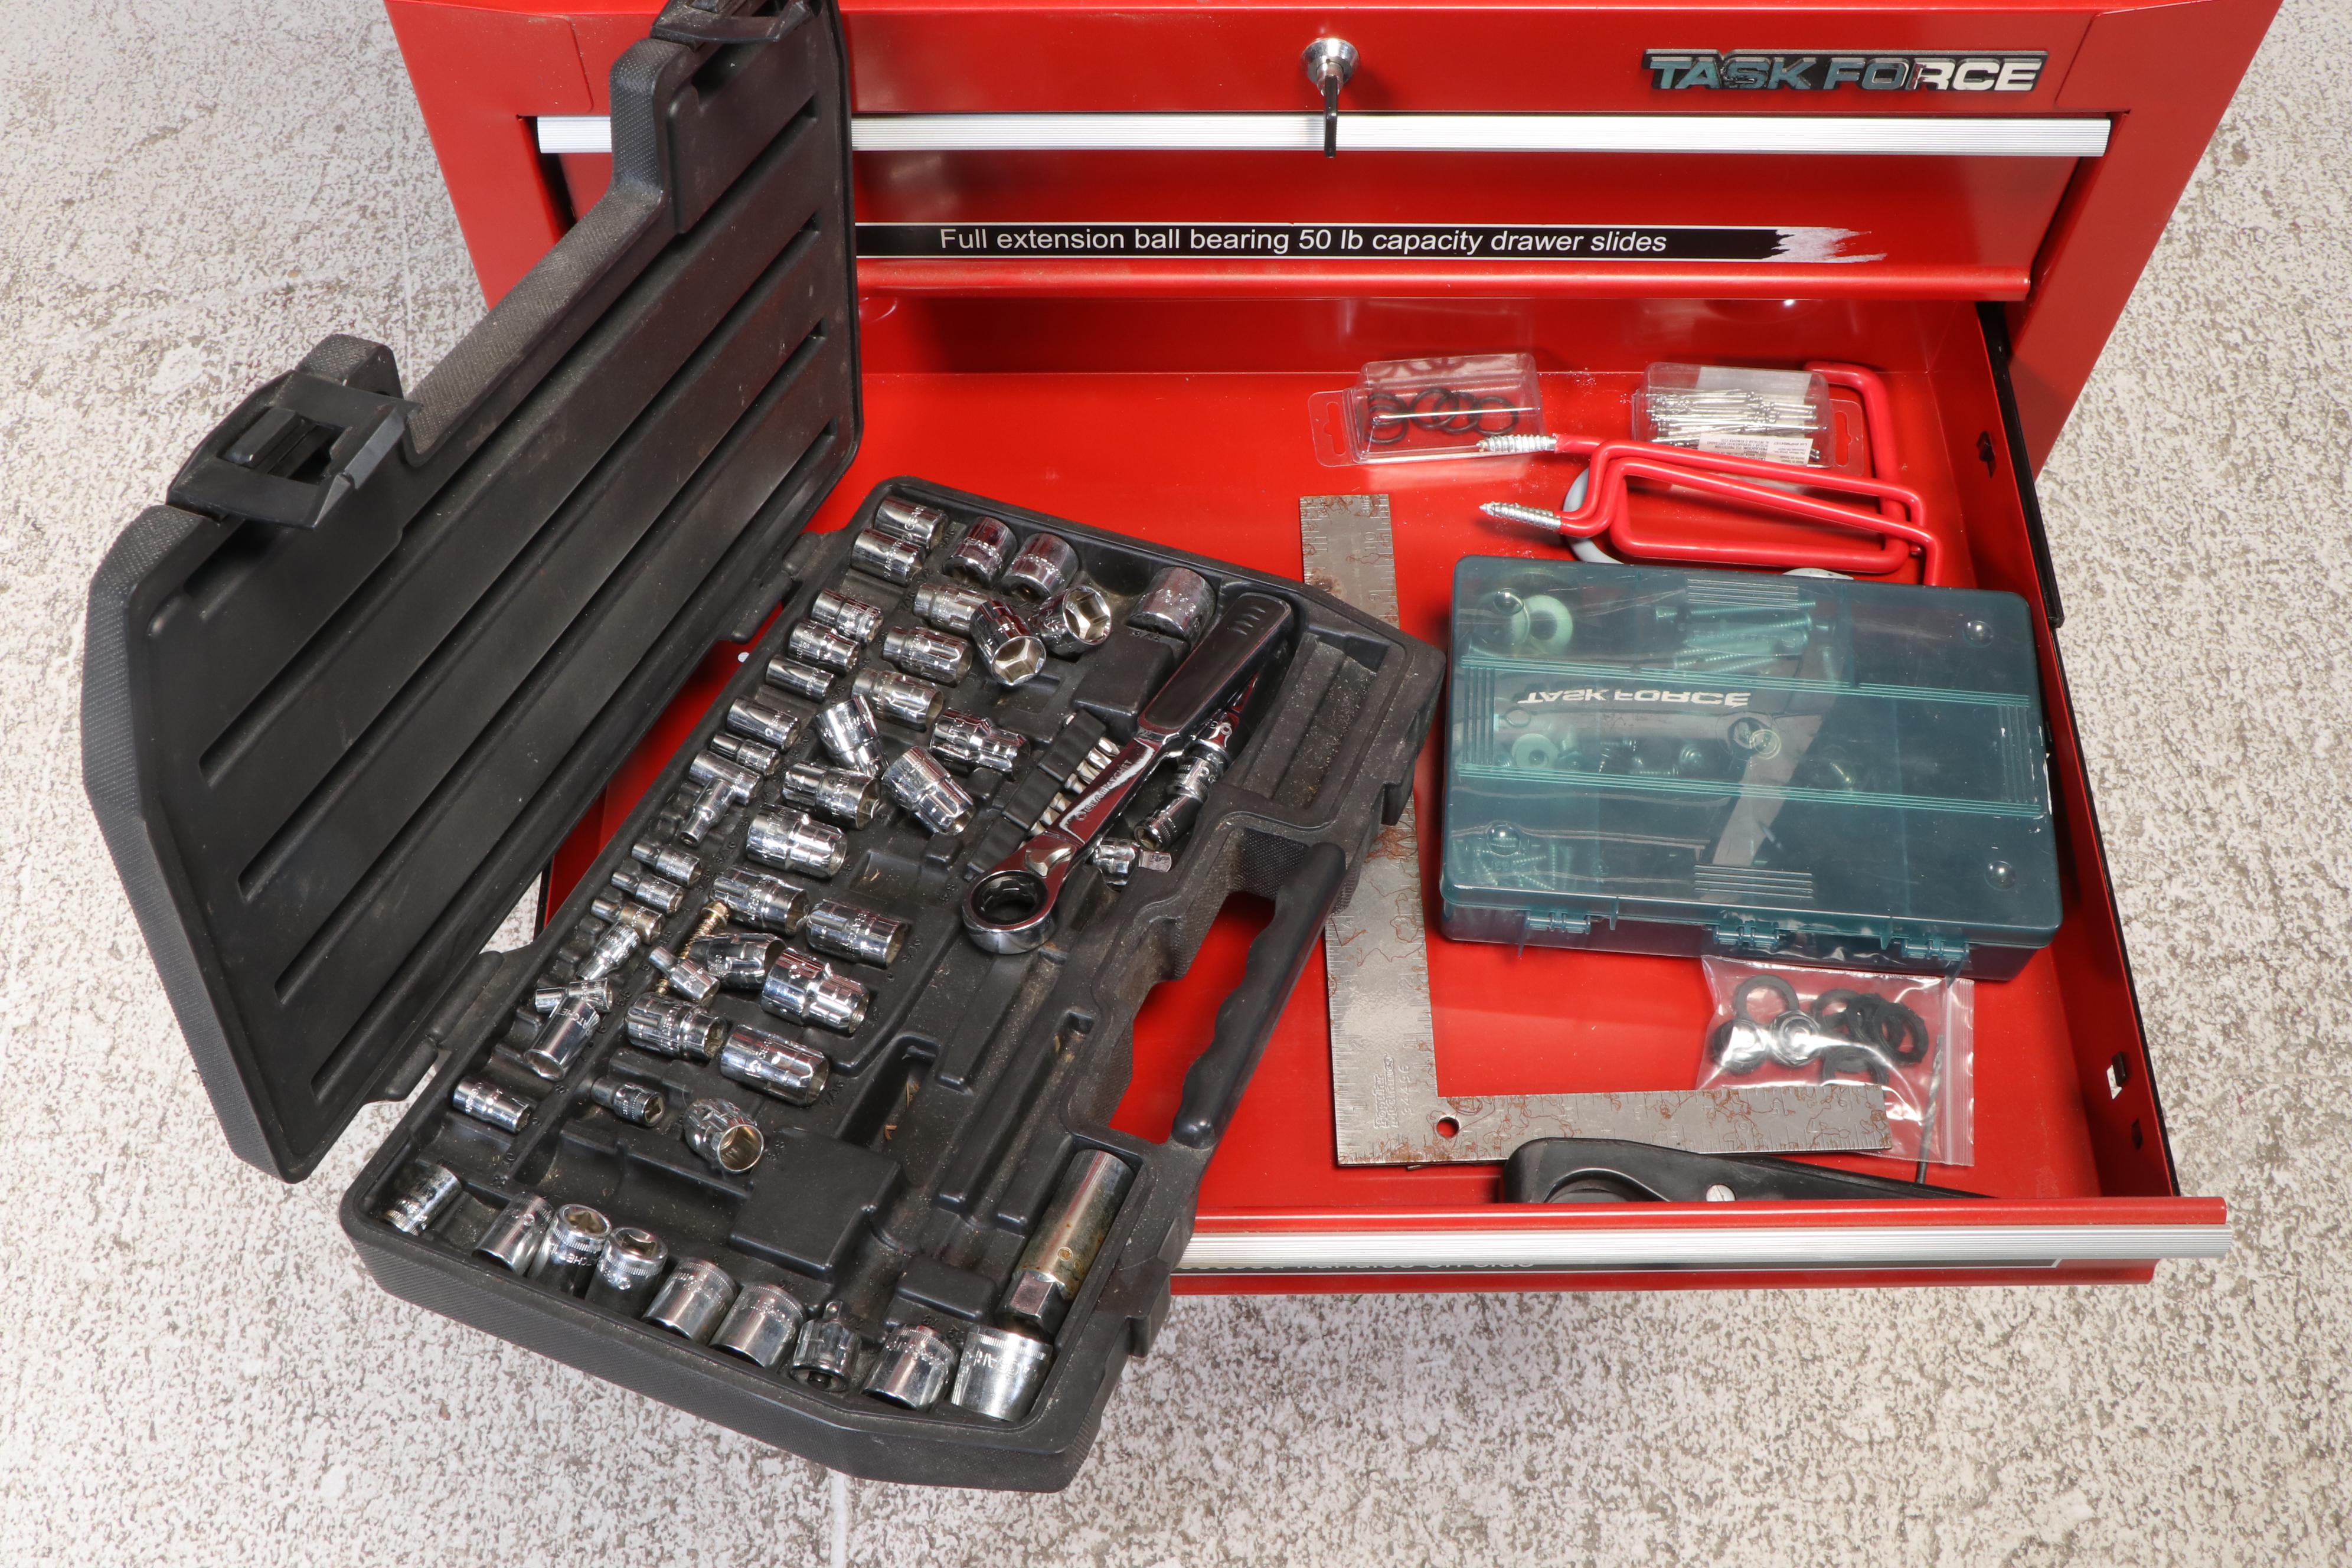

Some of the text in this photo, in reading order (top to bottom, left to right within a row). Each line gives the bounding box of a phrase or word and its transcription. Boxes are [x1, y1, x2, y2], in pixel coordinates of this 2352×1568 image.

[1650, 57, 2042, 91] TASK FORCE
[940, 228, 1667, 256] Full extension ball bearing 50 lb capacity drawer slides
